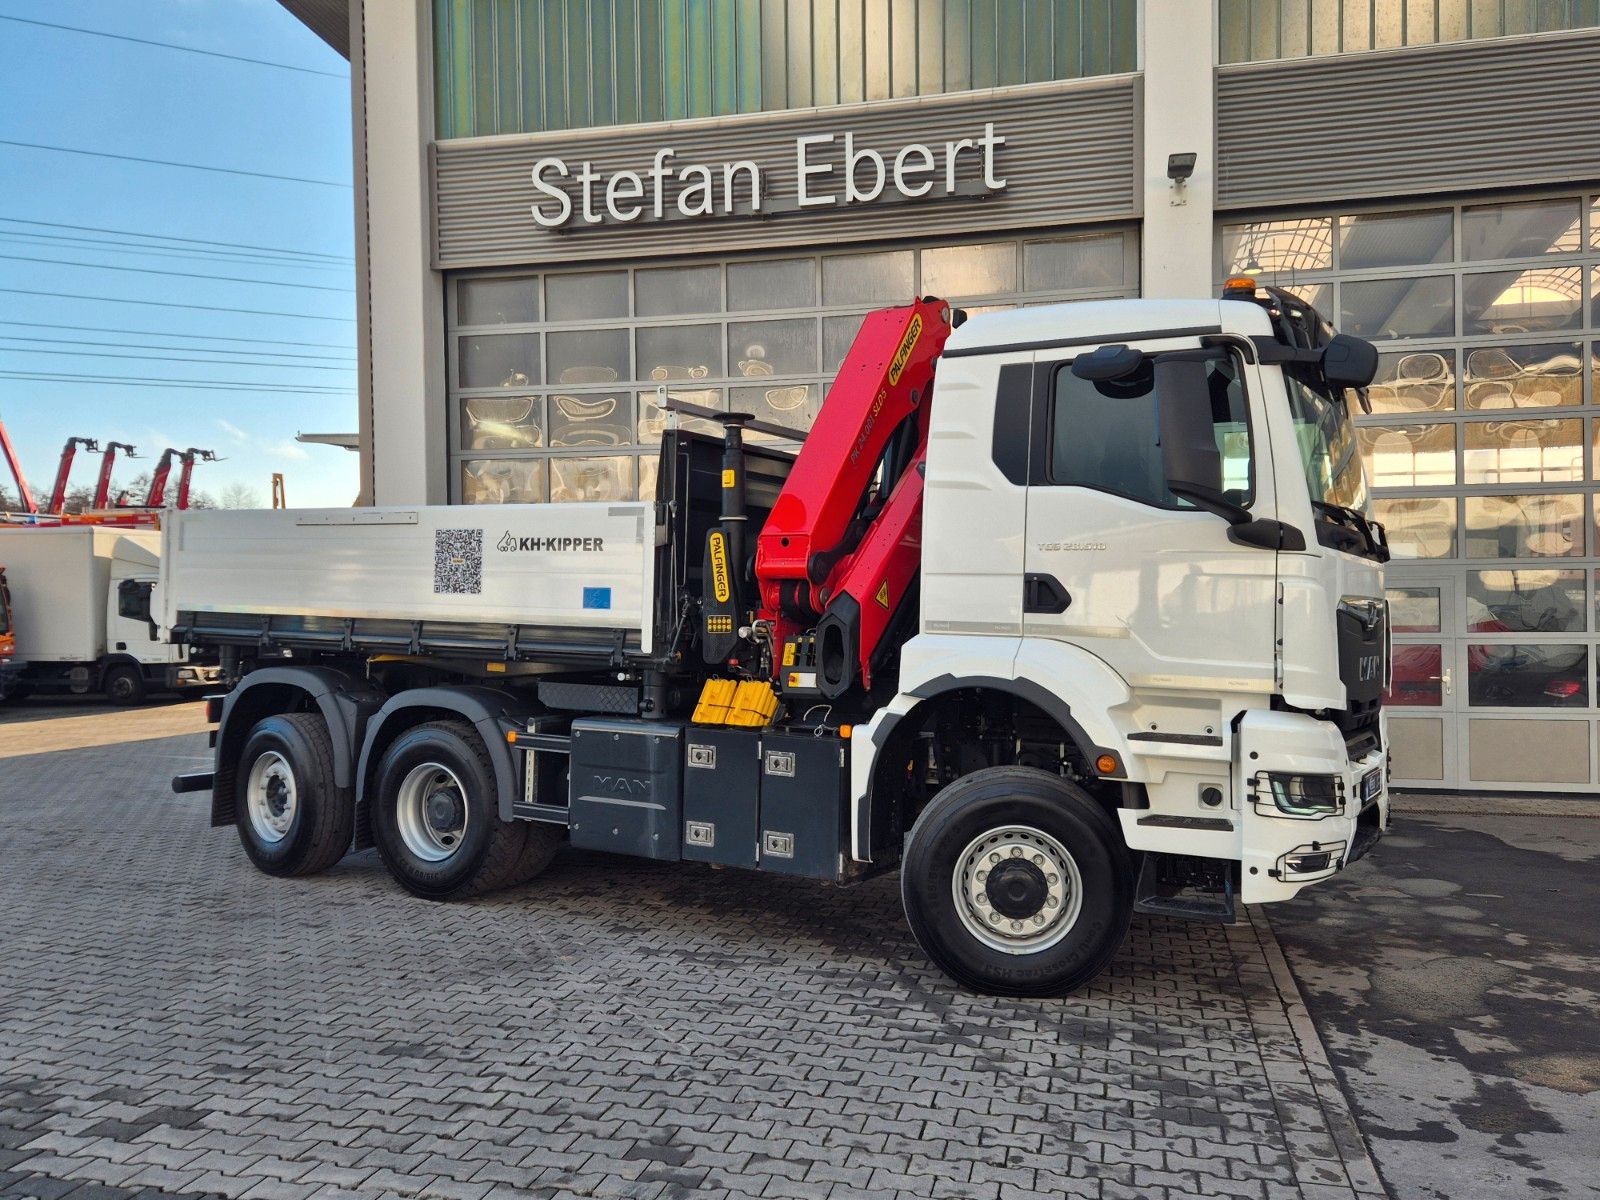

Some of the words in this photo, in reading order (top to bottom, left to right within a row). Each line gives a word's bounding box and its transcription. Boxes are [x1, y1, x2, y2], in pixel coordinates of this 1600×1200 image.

[530, 147, 762, 228] Stefan
[797, 122, 1007, 207] Ebert
[890, 318, 920, 383] PALFINGER
[519, 537, 604, 552] KH-KIPPER
[712, 536, 728, 598] PALFINGER
